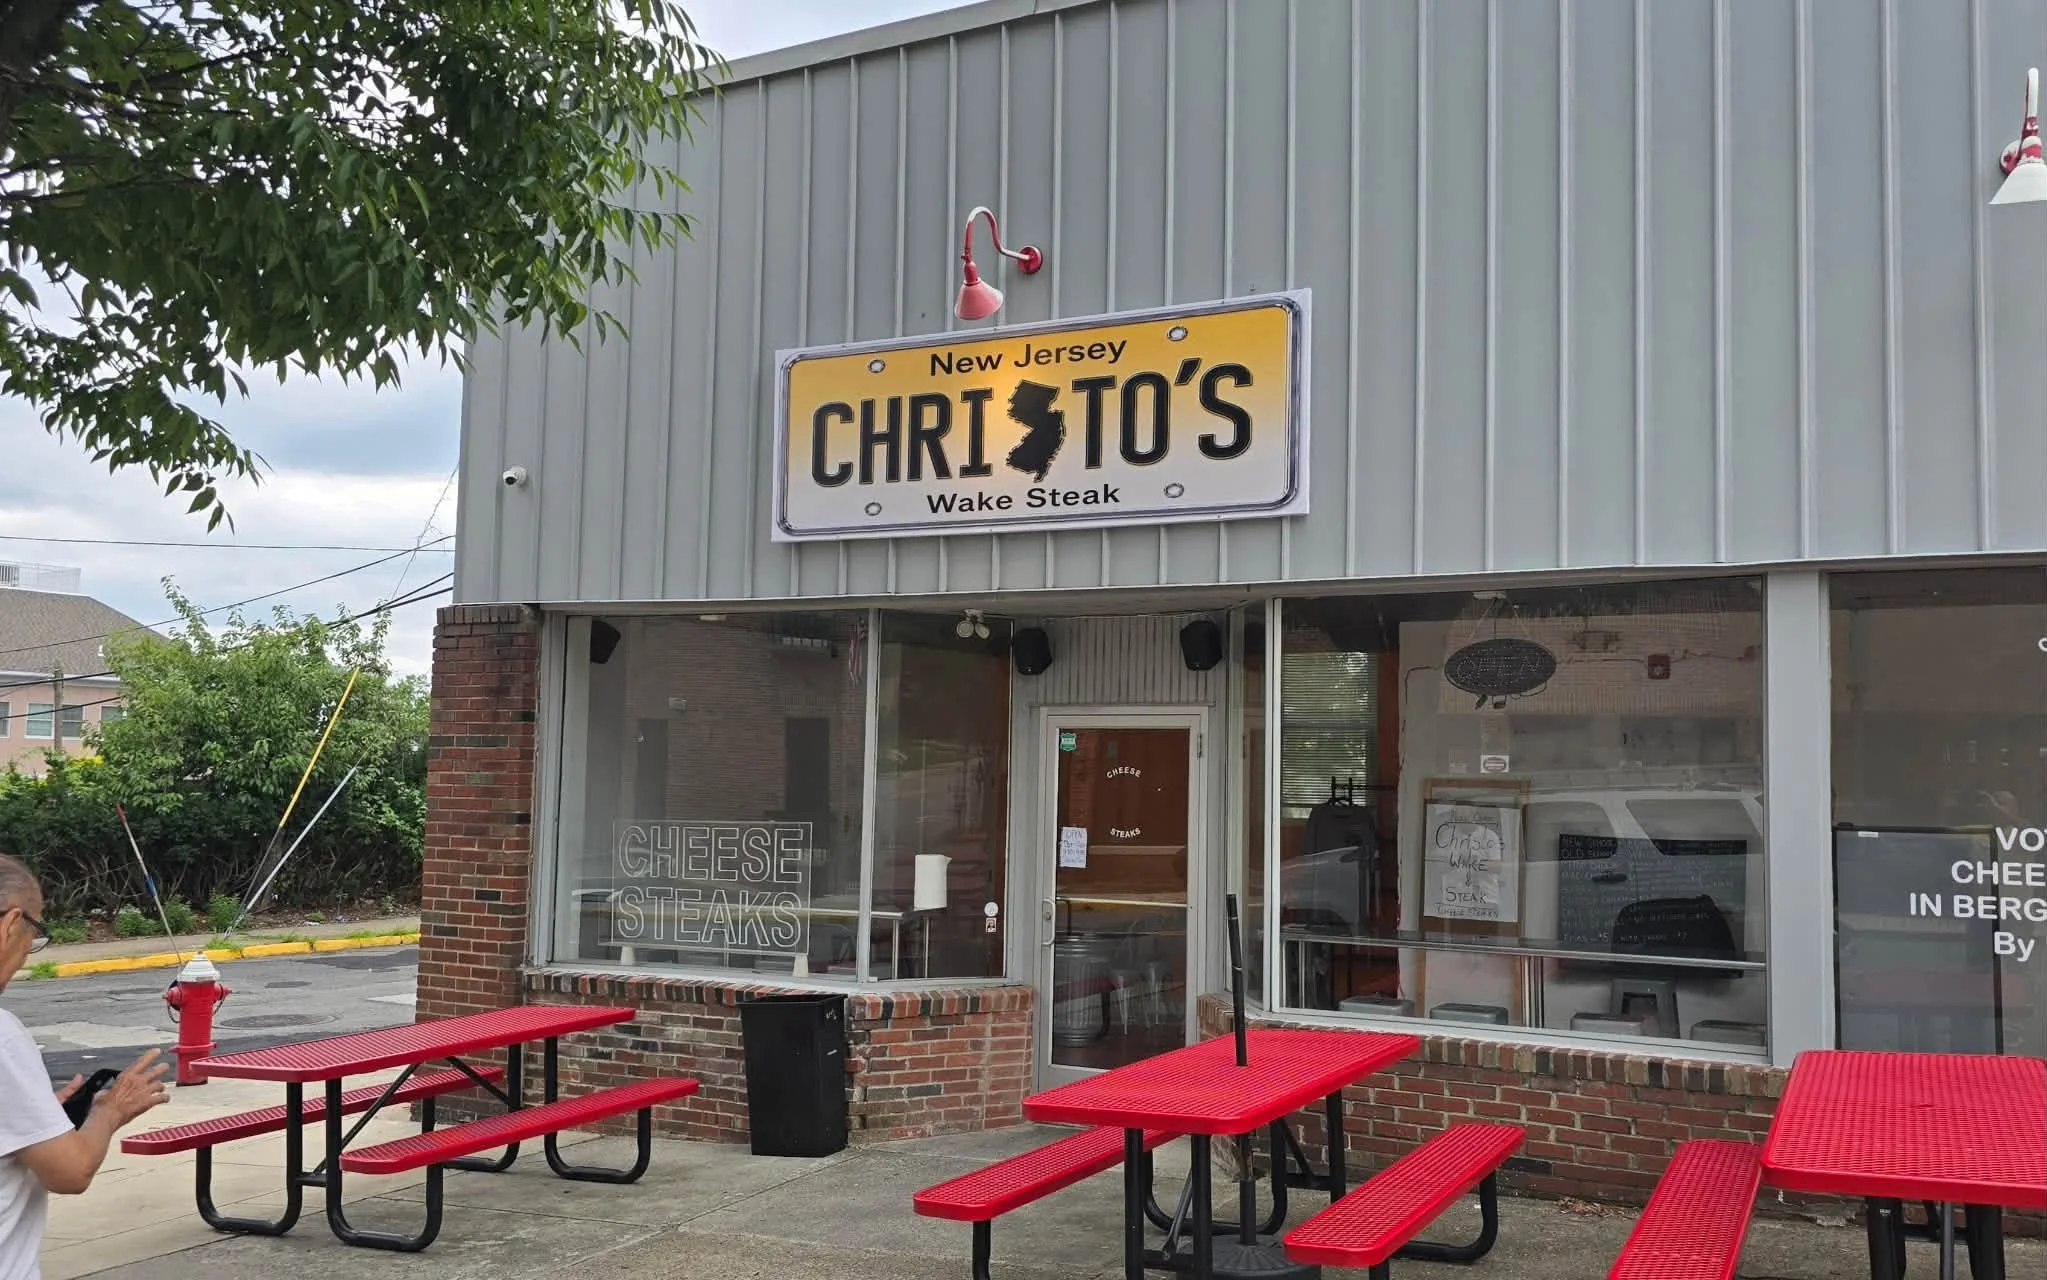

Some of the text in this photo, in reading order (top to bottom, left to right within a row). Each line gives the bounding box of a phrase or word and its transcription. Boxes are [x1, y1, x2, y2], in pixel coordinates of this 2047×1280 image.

[930, 338, 1128, 377] New Jersey
[926, 482, 1121, 514] Wake Steak
[1106, 766, 1142, 779] CHEESE
[1109, 827, 1141, 838] STEAKS
[1995, 826, 2047, 852] VO
[618, 825, 804, 884] CHEESE
[617, 886, 802, 948] STEAKS
[1909, 892, 1942, 917] IN
[1993, 931, 2035, 962] By
